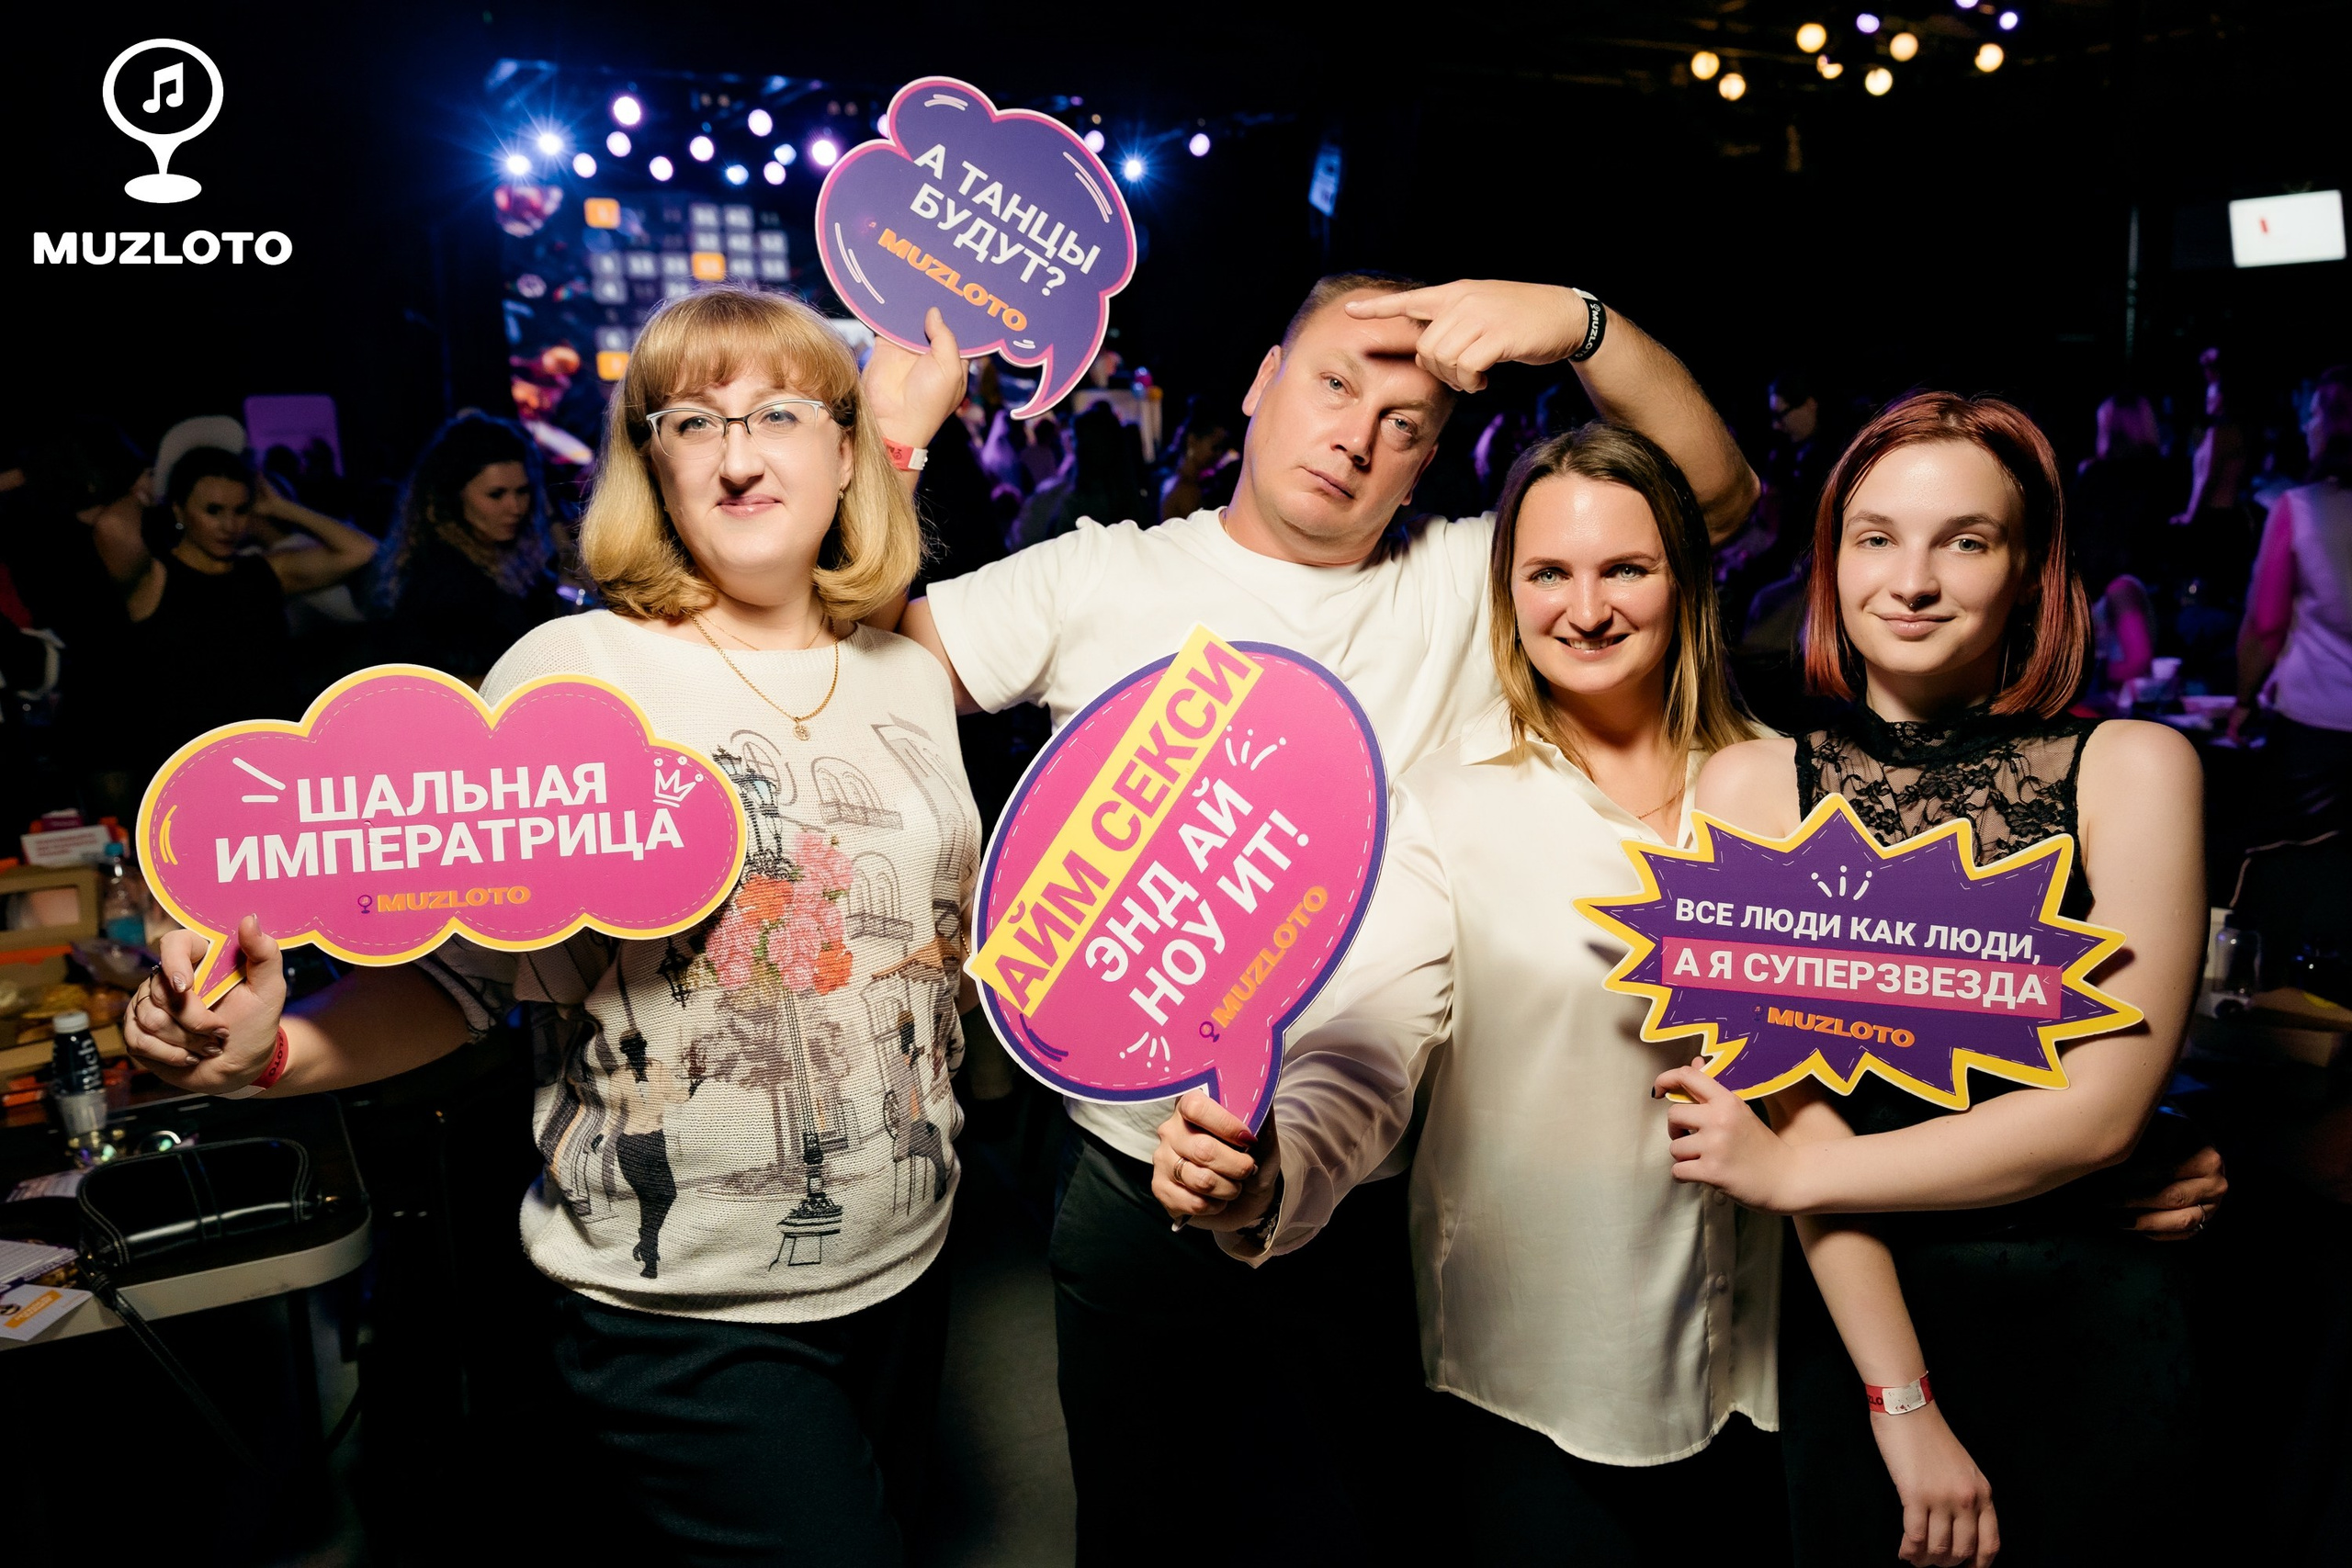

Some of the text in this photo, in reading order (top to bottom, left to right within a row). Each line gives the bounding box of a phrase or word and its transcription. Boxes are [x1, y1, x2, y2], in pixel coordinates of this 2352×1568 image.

[909, 182, 1067, 297] БУДУТ?
[913, 143, 1102, 275] А ТАНЦЫ
[877, 228, 1028, 332] MUZLOTO
[1575, 310, 1600, 358] MUZLOTO
[297, 761, 608, 823] ШАЛЬНАЯ
[994, 640, 1252, 1010] АЙМ СЕКСИ
[216, 808, 685, 884] ИМПЕРАТРИЦА
[1084, 776, 1254, 982] ЭНД АЙ
[378, 885, 531, 913] MUZLOTO
[1128, 808, 1310, 1027] НОУ ИТ!
[1675, 897, 2043, 966] ВСЕ ЛЮДИ КАК ЛЮДИ,
[1210, 885, 1329, 1030] MUZLOTO
[1673, 947, 2049, 1010] А Я СУПЕРЗВЕЗДА
[268, 1031, 284, 1077] ZLOTO
[1767, 1006, 1916, 1048] MUZLOTO
